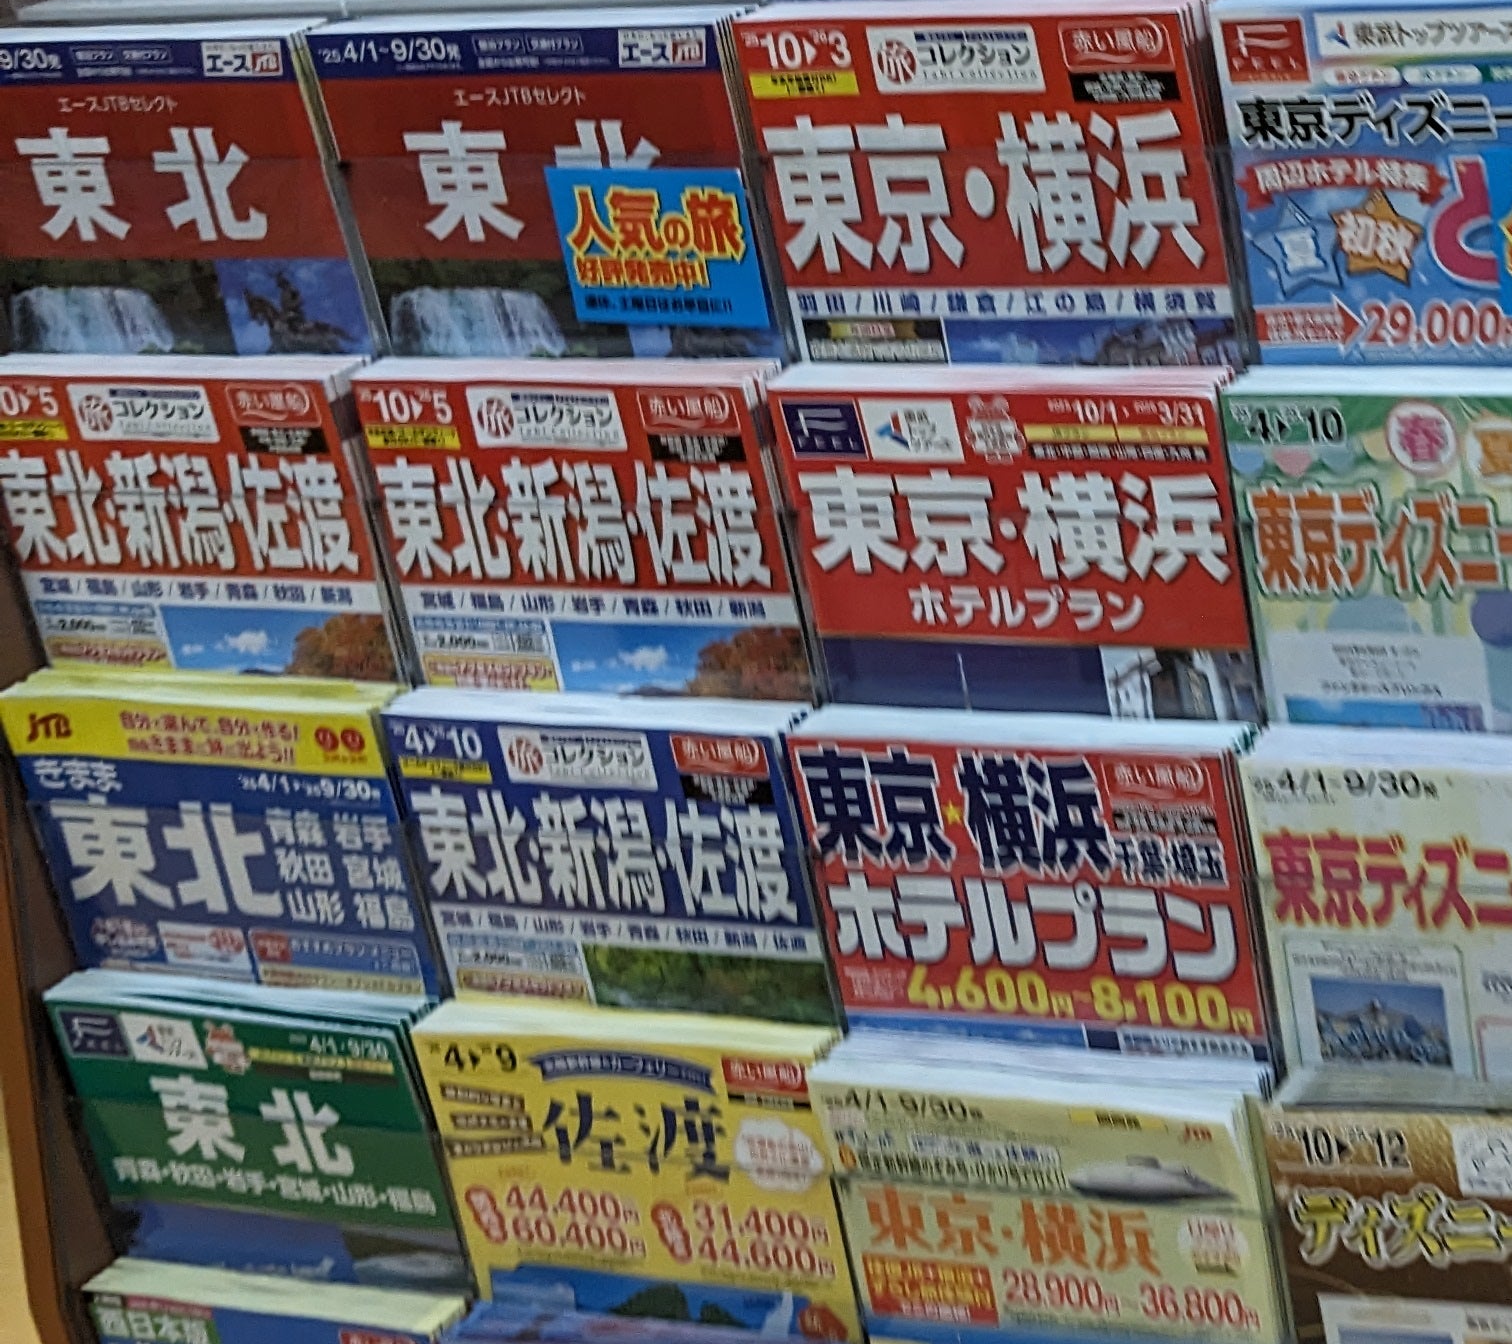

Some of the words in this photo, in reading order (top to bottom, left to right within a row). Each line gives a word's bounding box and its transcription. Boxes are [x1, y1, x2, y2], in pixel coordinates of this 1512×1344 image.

[621, 42, 671, 63] エース
[918, 43, 1032, 67] コレクション
[1072, 26, 1157, 55] 赤い風船
[454, 87, 586, 107] エースJTBセレクト
[15, 127, 268, 242] 東北
[763, 110, 1206, 273] 東京・横浜
[1257, 160, 1430, 192] 周辺ホテル特集
[568, 186, 746, 265] 人気の旅
[514, 407, 612, 428] コレクション
[0, 448, 359, 574] 東北・新潟・佐渡
[376, 456, 772, 589] 東北・新潟・佐渡
[798, 466, 1231, 584] 東京・横浜
[908, 583, 1144, 633] ホテルプラン
[27, 713, 73, 742] JTB
[33, 759, 122, 792] きまま
[543, 745, 643, 766] コレクション
[266, 808, 326, 848] 青森
[333, 813, 392, 853] 岩手
[794, 744, 956, 869] 東京
[955, 749, 1116, 881] 横浜
[49, 793, 284, 917] 東北
[275, 848, 335, 885] 秋田
[343, 854, 403, 891] 宮城
[409, 784, 798, 923] 東北・新潟・佐渡
[287, 891, 344, 926] 山形
[354, 893, 415, 932] 福島
[827, 870, 1237, 983] ホテルプラン
[150, 1075, 354, 1177] 東北
[544, 1091, 730, 1183] 佐渡
[507, 1185, 640, 1226] 44,400円
[860, 1184, 1162, 1277] 東京・横浜
